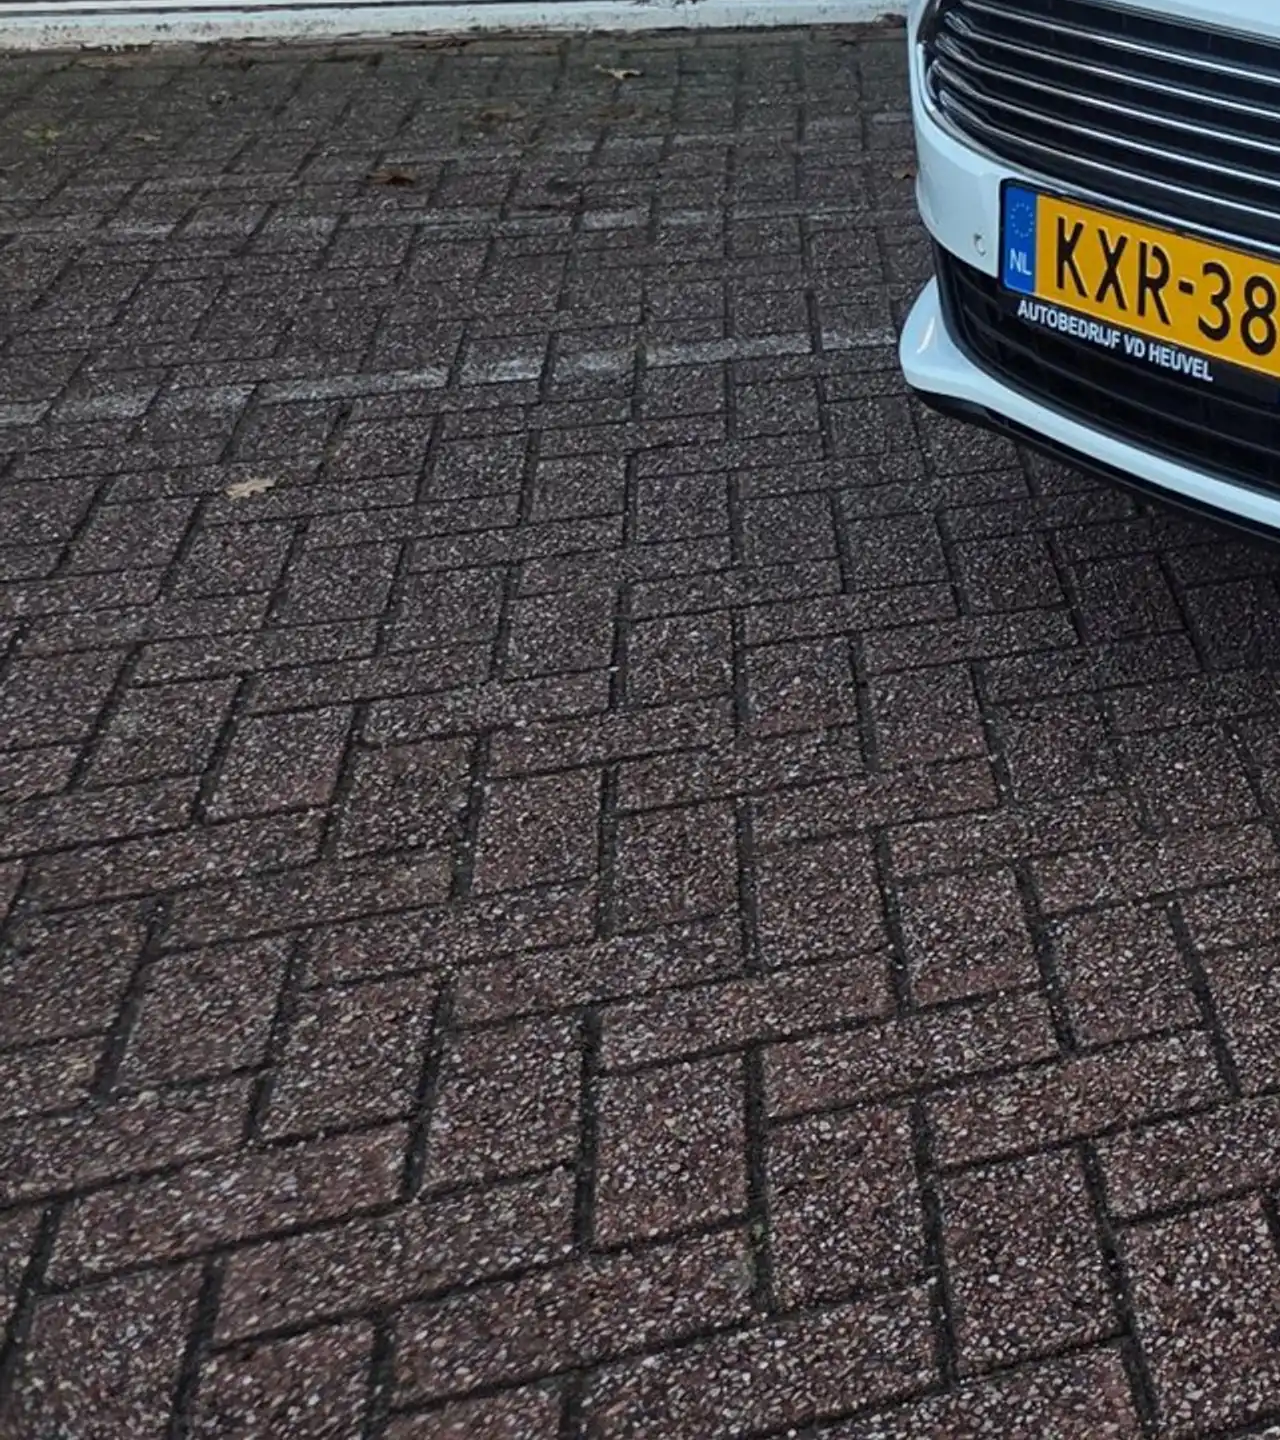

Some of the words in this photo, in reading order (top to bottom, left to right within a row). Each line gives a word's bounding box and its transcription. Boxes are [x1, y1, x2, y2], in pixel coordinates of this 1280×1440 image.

[1009, 247, 1032, 276] NL
[1017, 299, 1121, 350] AUTOBEDRIJF
[1124, 333, 1146, 358] VD
[1148, 342, 1214, 382] HEUVEL
